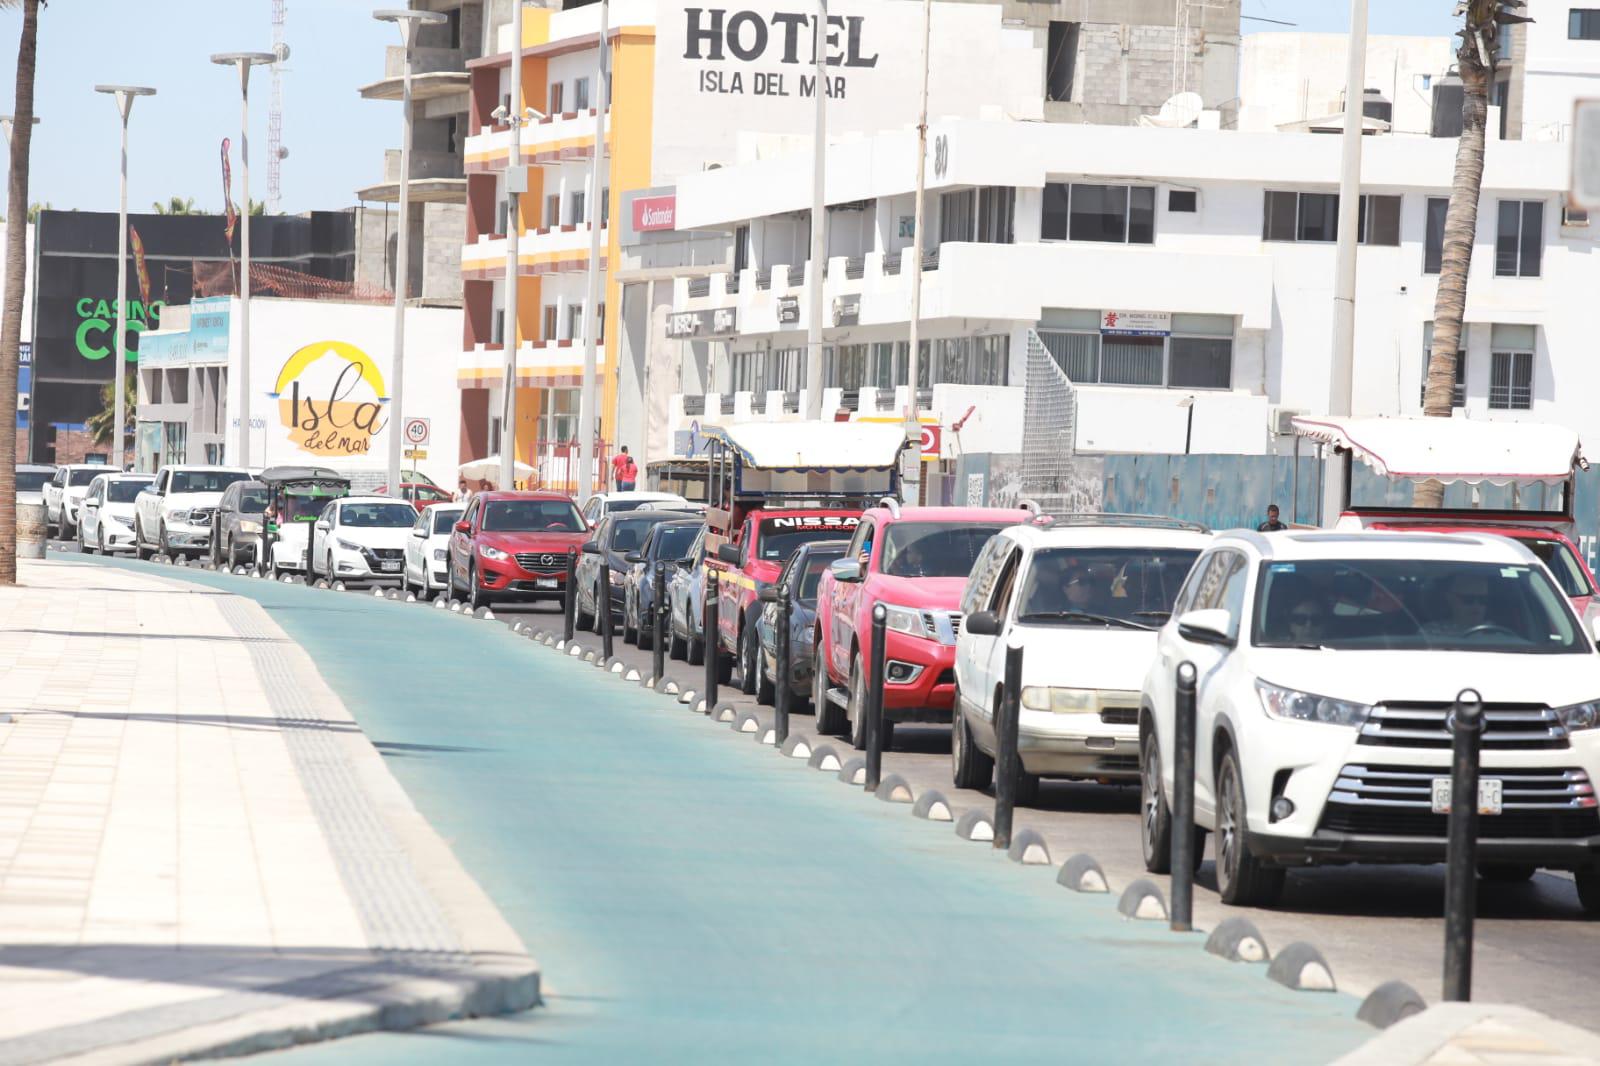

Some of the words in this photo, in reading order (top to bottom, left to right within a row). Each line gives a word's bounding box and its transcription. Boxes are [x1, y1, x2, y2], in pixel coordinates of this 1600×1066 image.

[683, 8, 879, 68] HOTEL
[700, 70, 744, 94] ISLA
[753, 72, 789, 96] DEL
[799, 75, 846, 99] MAR
[291, 361, 389, 435] Isla
[303, 430, 338, 450] del
[411, 424, 424, 435] 40
